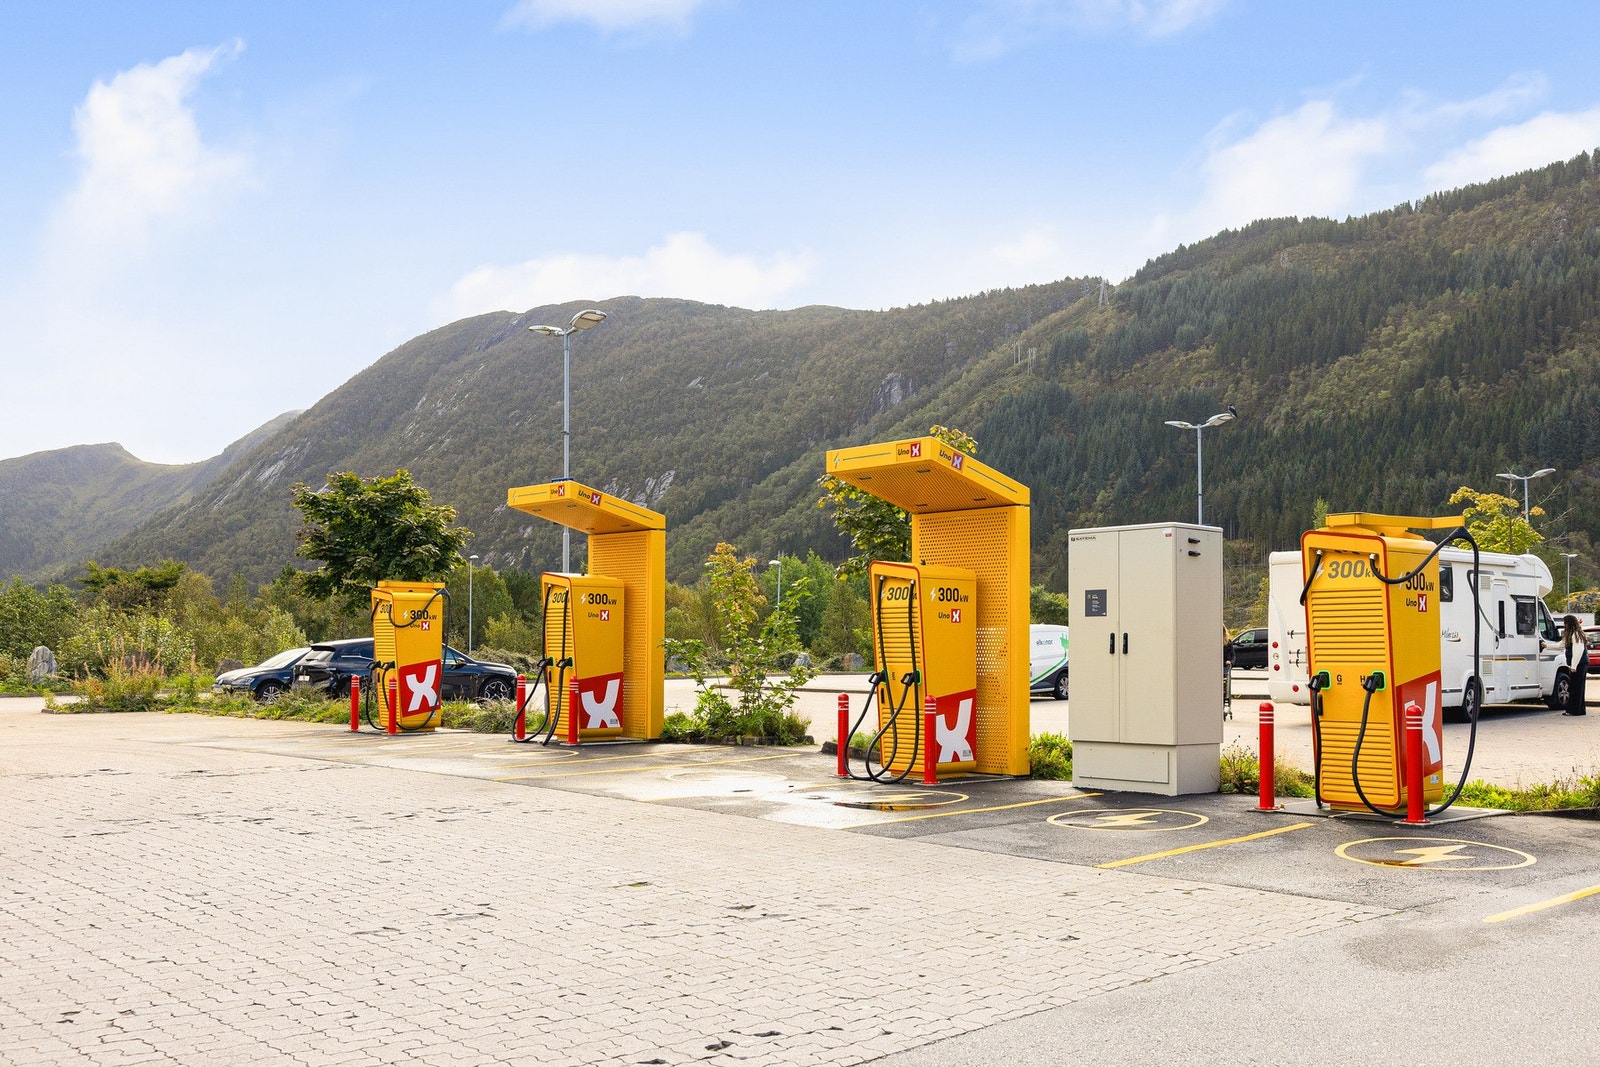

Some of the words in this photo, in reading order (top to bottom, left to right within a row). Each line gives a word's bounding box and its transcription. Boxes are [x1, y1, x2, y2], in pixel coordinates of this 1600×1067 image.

[897, 448, 910, 456] Uno
[910, 443, 921, 457] X
[939, 449, 952, 462] Uno
[952, 453, 964, 469] X
[578, 490, 591, 500] Uno
[591, 493, 601, 505] X
[1405, 597, 1418, 607] Uno
[1418, 594, 1427, 612] X
[600, 610, 609, 620] X
[938, 611, 950, 619] Uno
[951, 609, 961, 622] X
[1336, 674, 1343, 682] G
